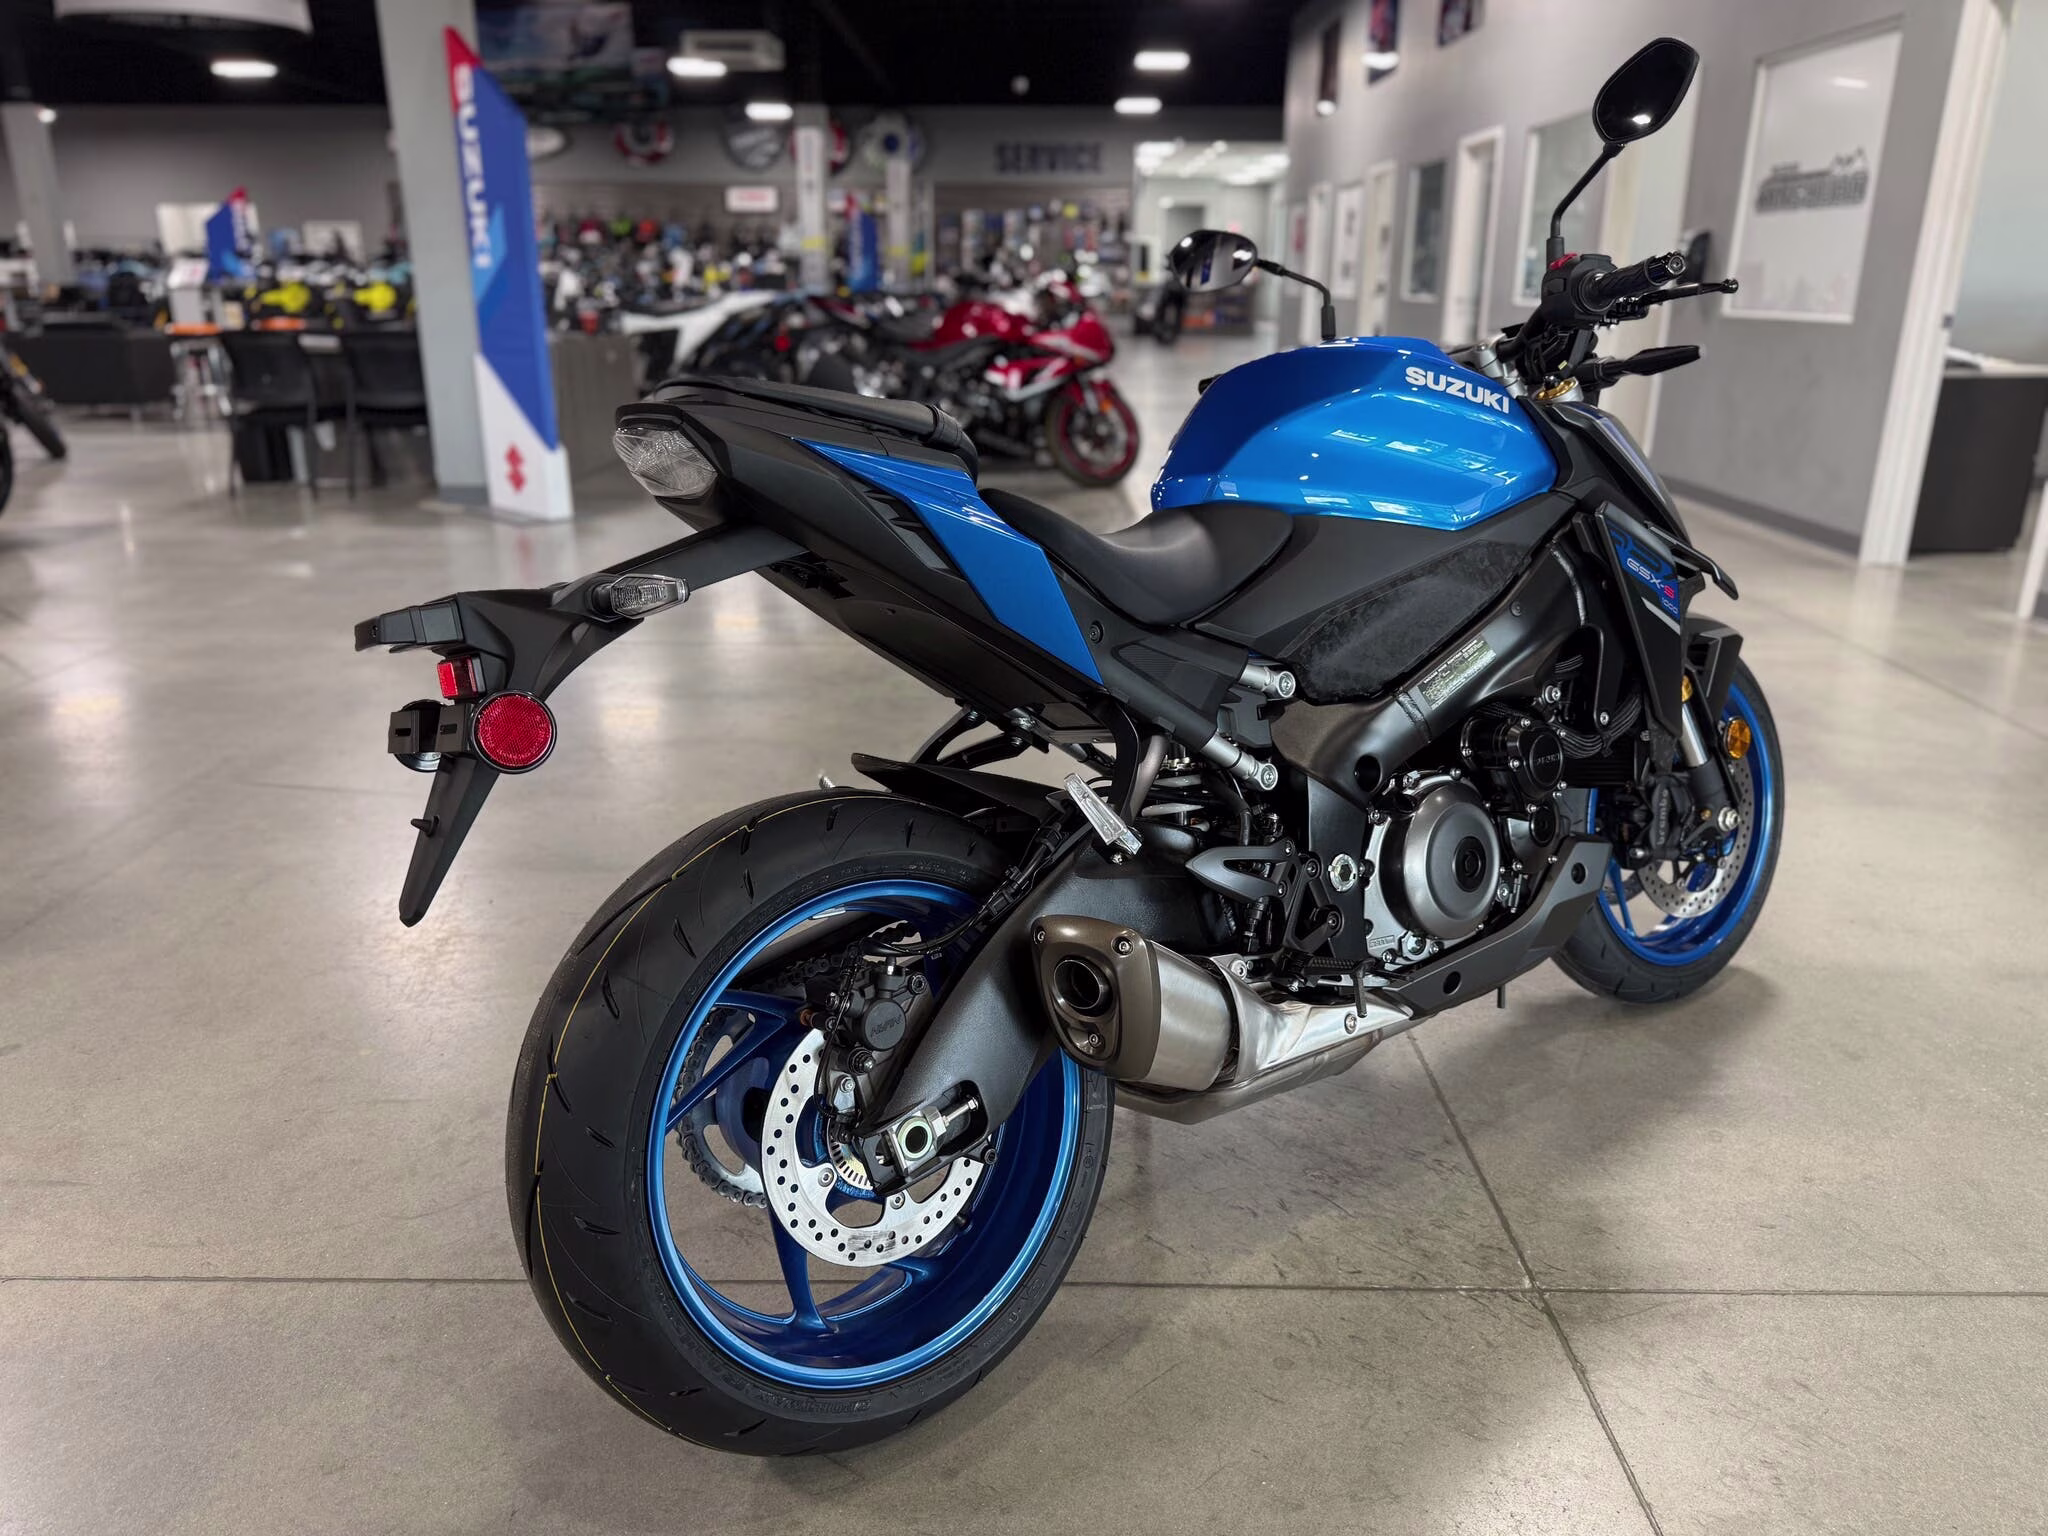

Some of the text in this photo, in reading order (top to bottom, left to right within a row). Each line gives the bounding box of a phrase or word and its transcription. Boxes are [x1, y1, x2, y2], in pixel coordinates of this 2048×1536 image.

[1405, 366, 1510, 415] SUZUKI
[1626, 558, 1675, 599] GSX-S
[1656, 788, 1669, 845] brembo
